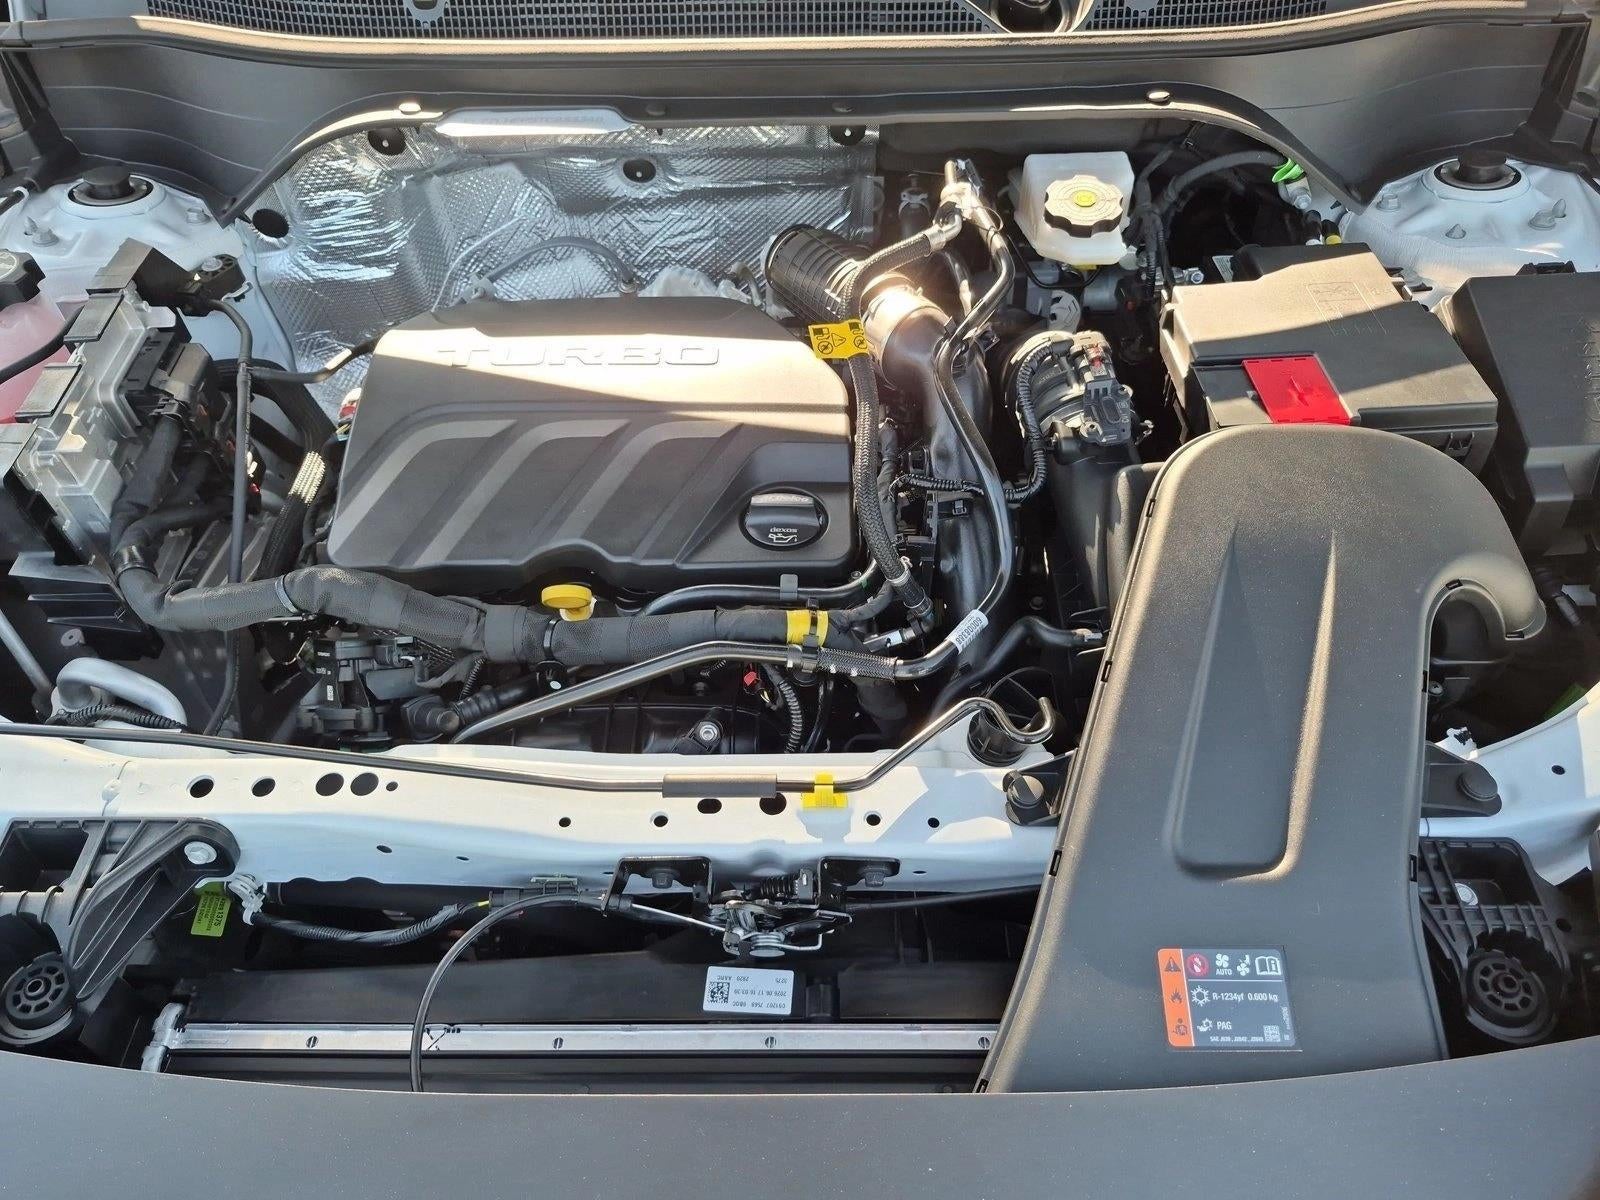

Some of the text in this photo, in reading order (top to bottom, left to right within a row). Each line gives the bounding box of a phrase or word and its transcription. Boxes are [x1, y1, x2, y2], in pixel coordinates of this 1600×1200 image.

[438, 346, 719, 367] TURBO
[1212, 991, 1279, 1003] R-1234yf 0.600 kg
[1216, 1020, 1232, 1031] PAG
